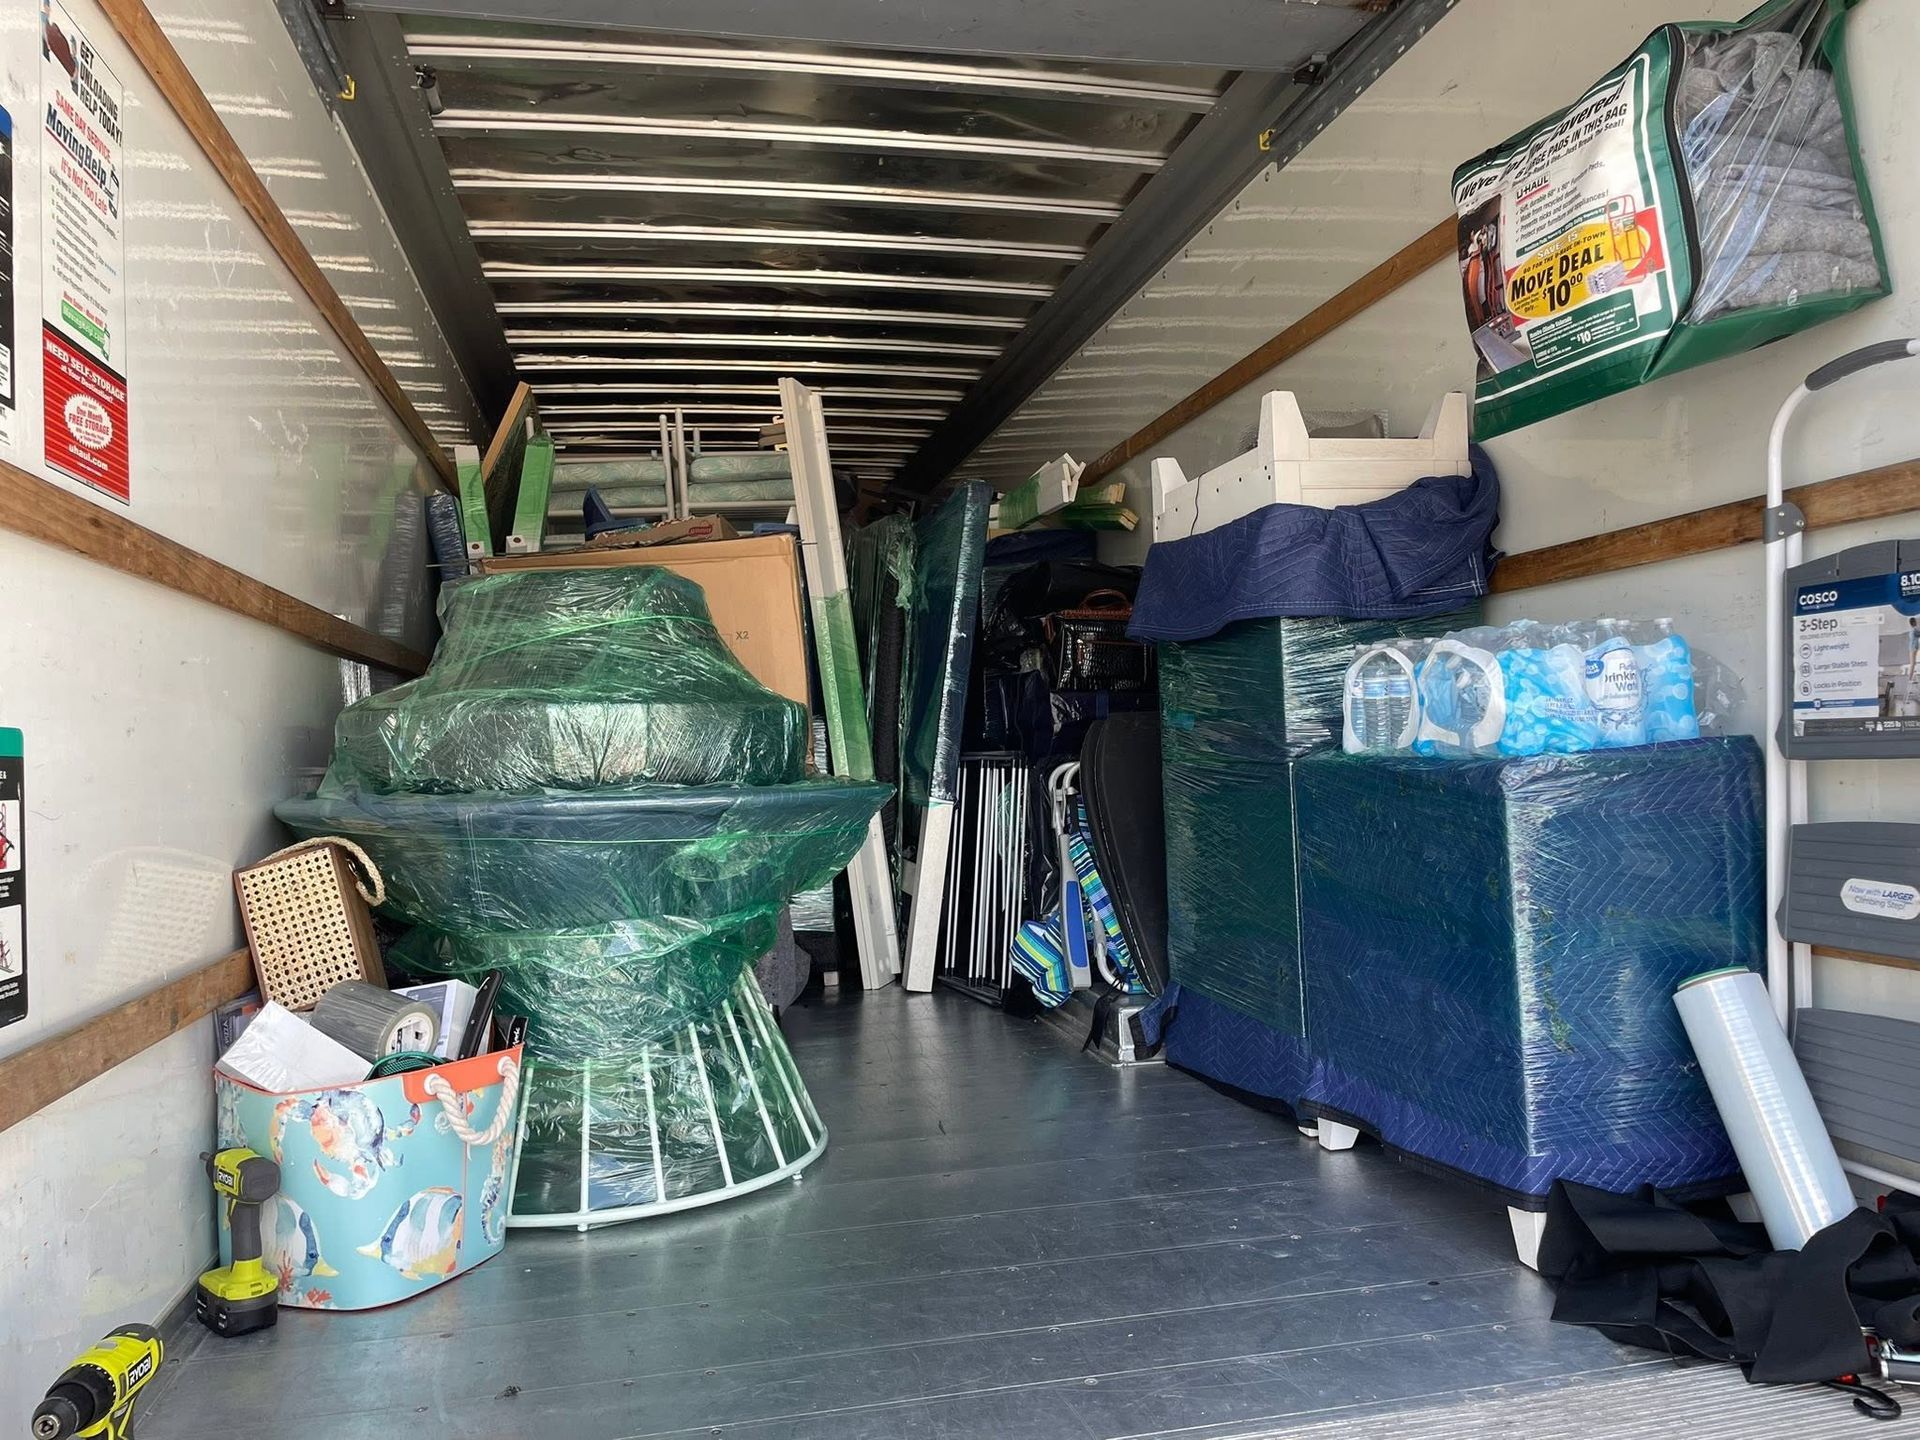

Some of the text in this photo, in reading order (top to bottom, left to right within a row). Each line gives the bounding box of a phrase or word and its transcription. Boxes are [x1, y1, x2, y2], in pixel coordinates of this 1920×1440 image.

[80, 41, 94, 69] GET
[80, 61, 118, 122] UNLOADING
[80, 84, 123, 147] HELP TODAY!
[1603, 103, 1628, 123] BAG
[1458, 175, 1498, 203] We've
[1511, 266, 1554, 302] MOVE
[1559, 243, 1605, 279] DEAL
[46, 339, 126, 402] NEED SELF-STORAGE
[68, 443, 109, 472] uhaul.com
[1799, 590, 1838, 605] COSCO
[735, 630, 749, 641] X2
[1800, 618, 1838, 632] 3-Step
[1882, 890, 1914, 901] LARGER
[128, 1355, 151, 1386] RYOBI
